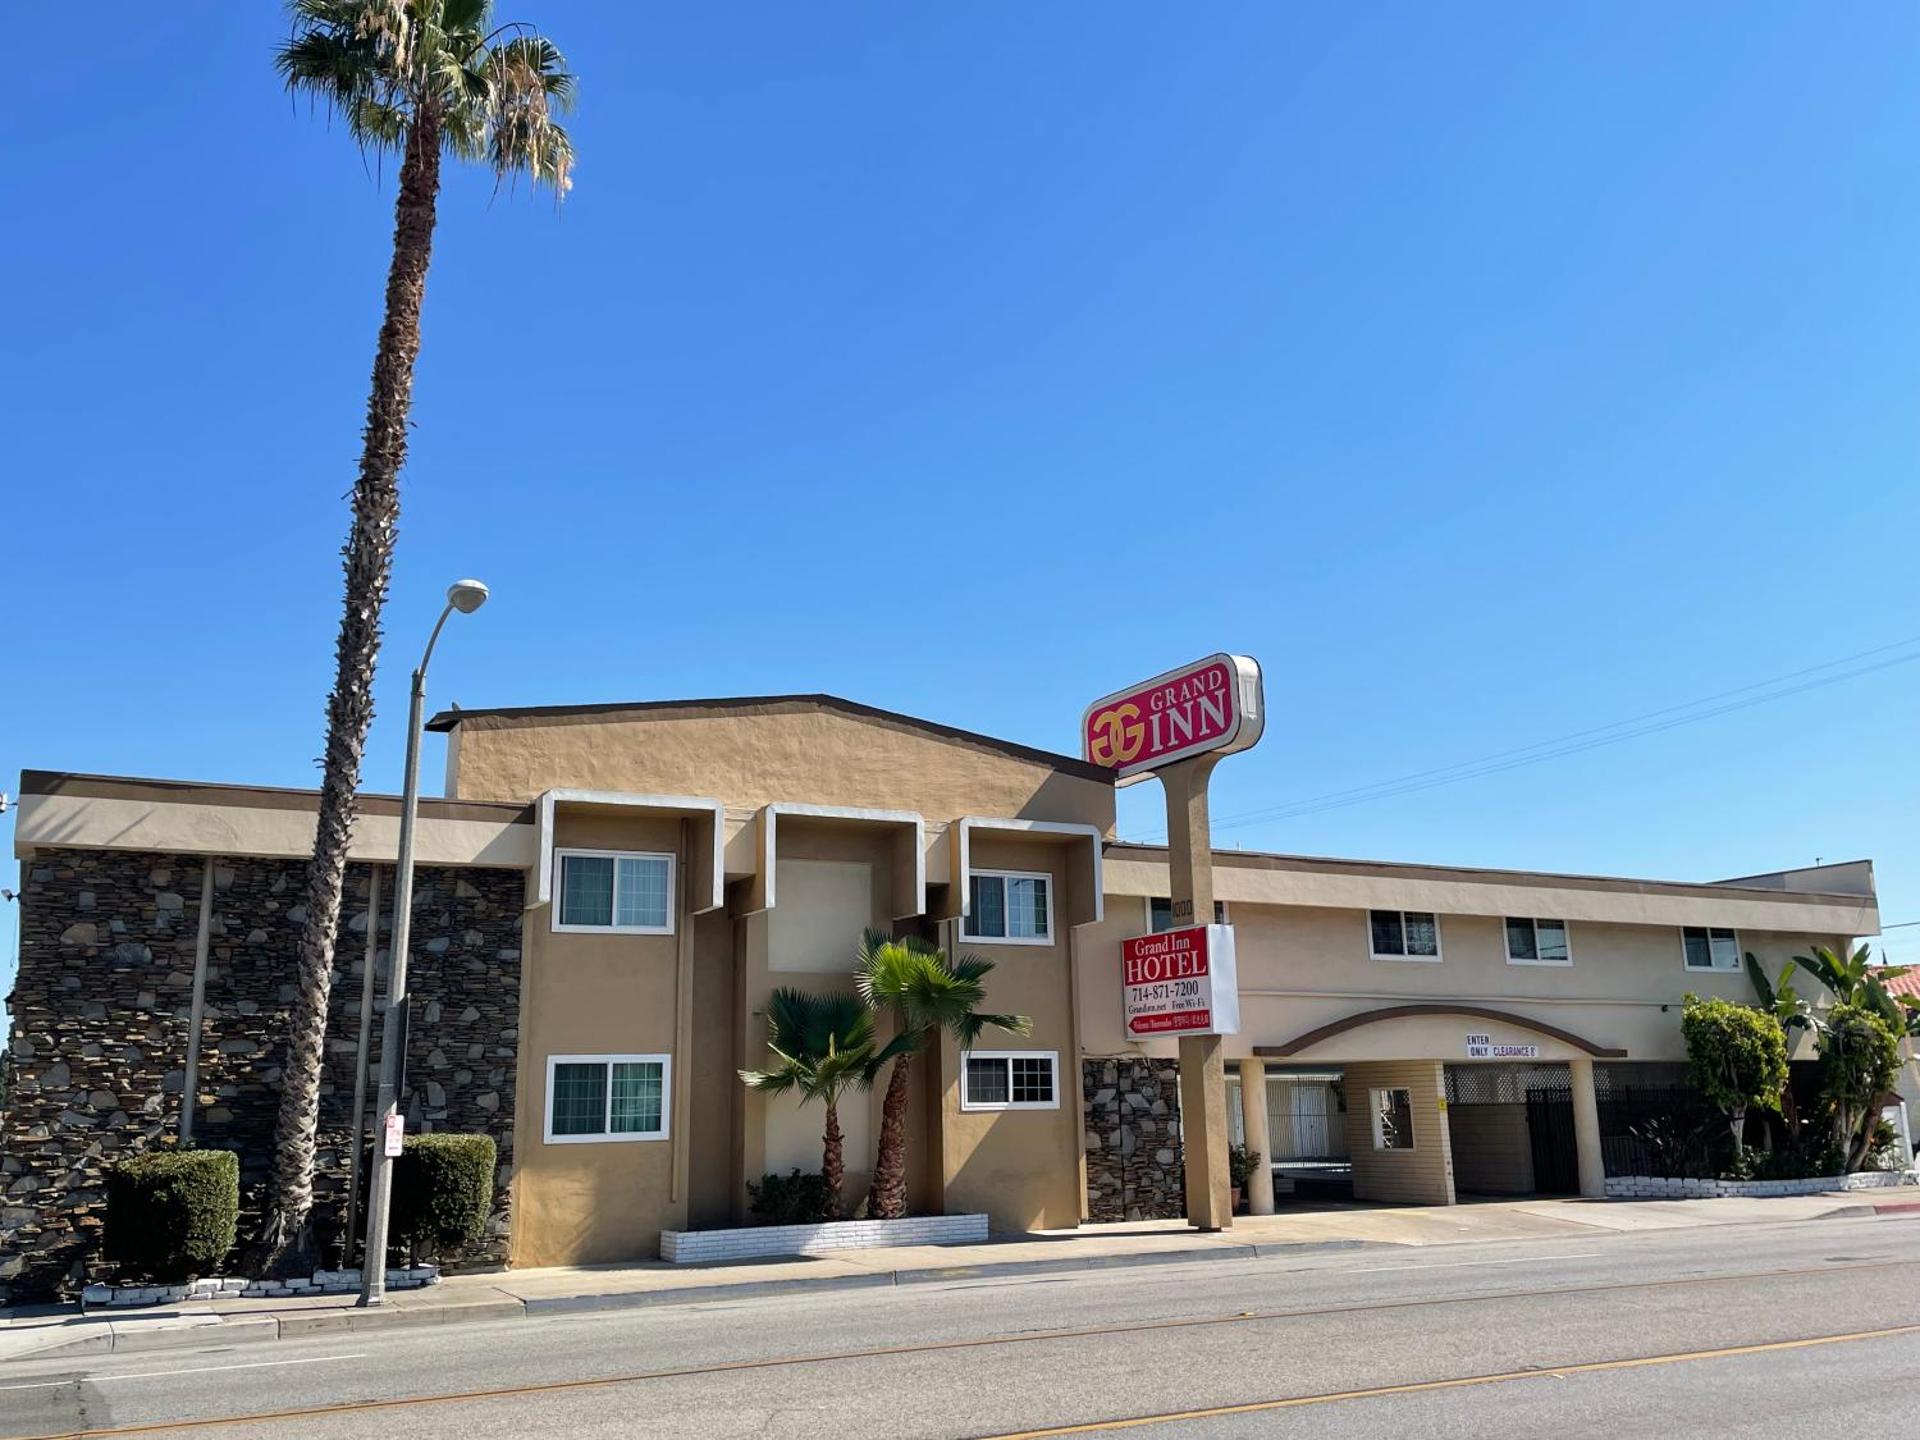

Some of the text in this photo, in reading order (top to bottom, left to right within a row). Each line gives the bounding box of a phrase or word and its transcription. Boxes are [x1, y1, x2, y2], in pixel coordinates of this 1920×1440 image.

[1150, 670, 1222, 711] GRAND
[1149, 687, 1226, 752] INN
[1134, 934, 1190, 956] Grand Inn
[1126, 950, 1207, 982] HOTEL
[1132, 980, 1199, 1002] 714-871-7200
[1466, 1035, 1489, 1045] ENTER
[1470, 1047, 1488, 1056] ONLY
[1493, 1047, 1529, 1056] CLEARANCE
